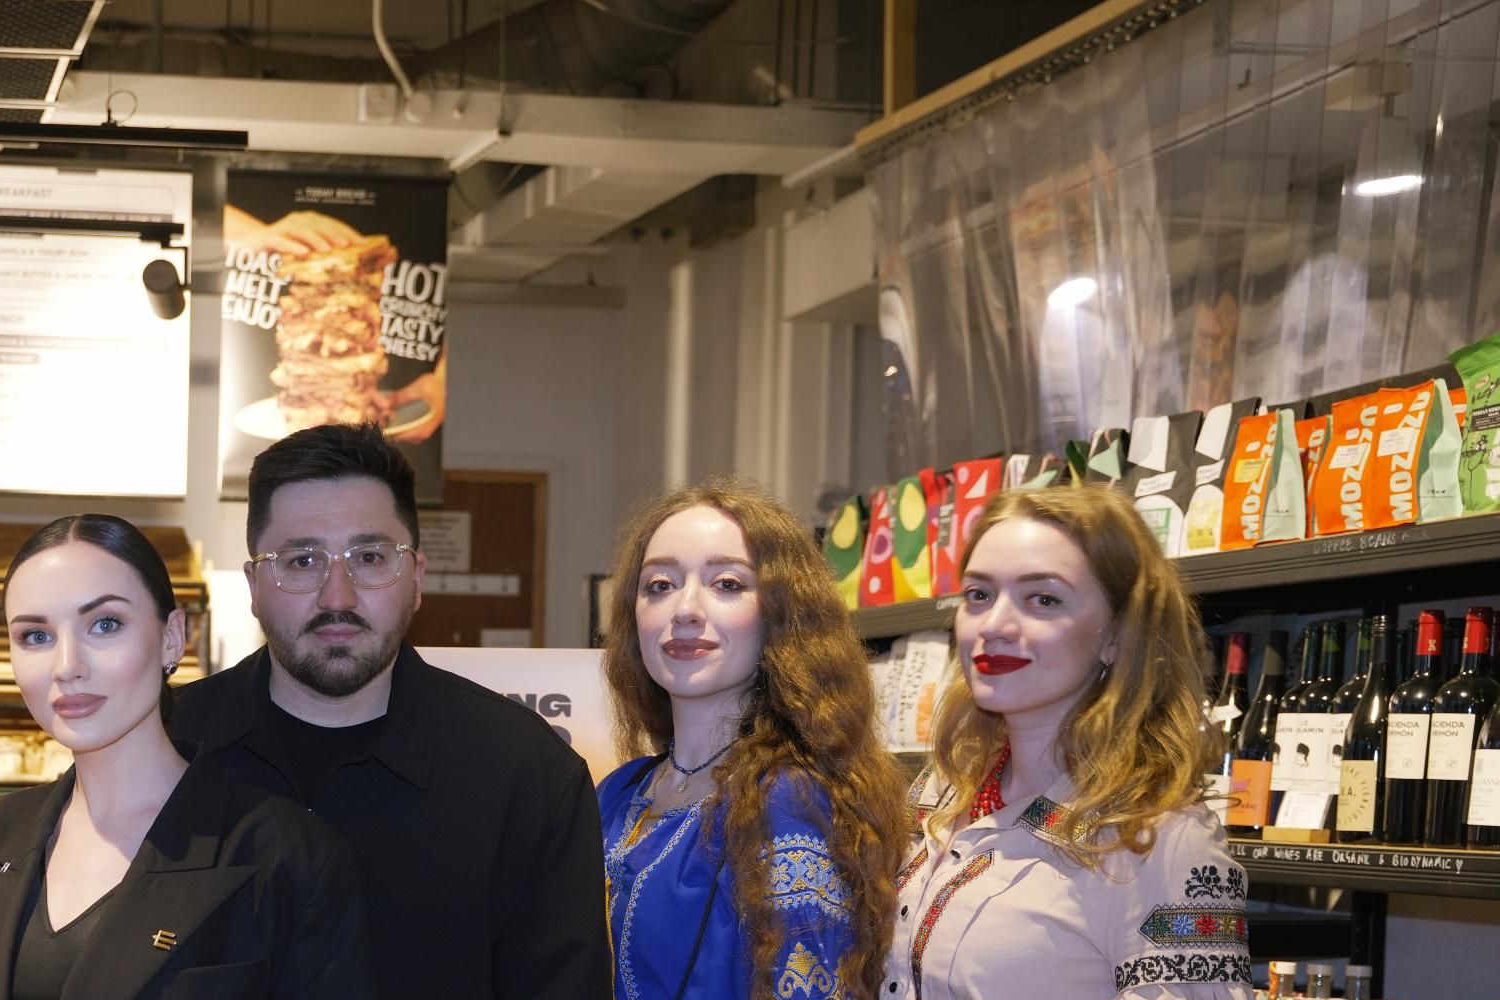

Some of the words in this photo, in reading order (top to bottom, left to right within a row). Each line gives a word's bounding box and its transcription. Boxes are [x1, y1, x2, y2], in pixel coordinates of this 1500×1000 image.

[225, 268, 293, 304] MELT
[381, 260, 449, 305] HOT
[381, 313, 444, 344] TASTY
[500, 693, 572, 717] NG
[1253, 846, 1268, 859] OUR
[1274, 847, 1300, 861] WINES
[1306, 848, 1324, 862] ARE
